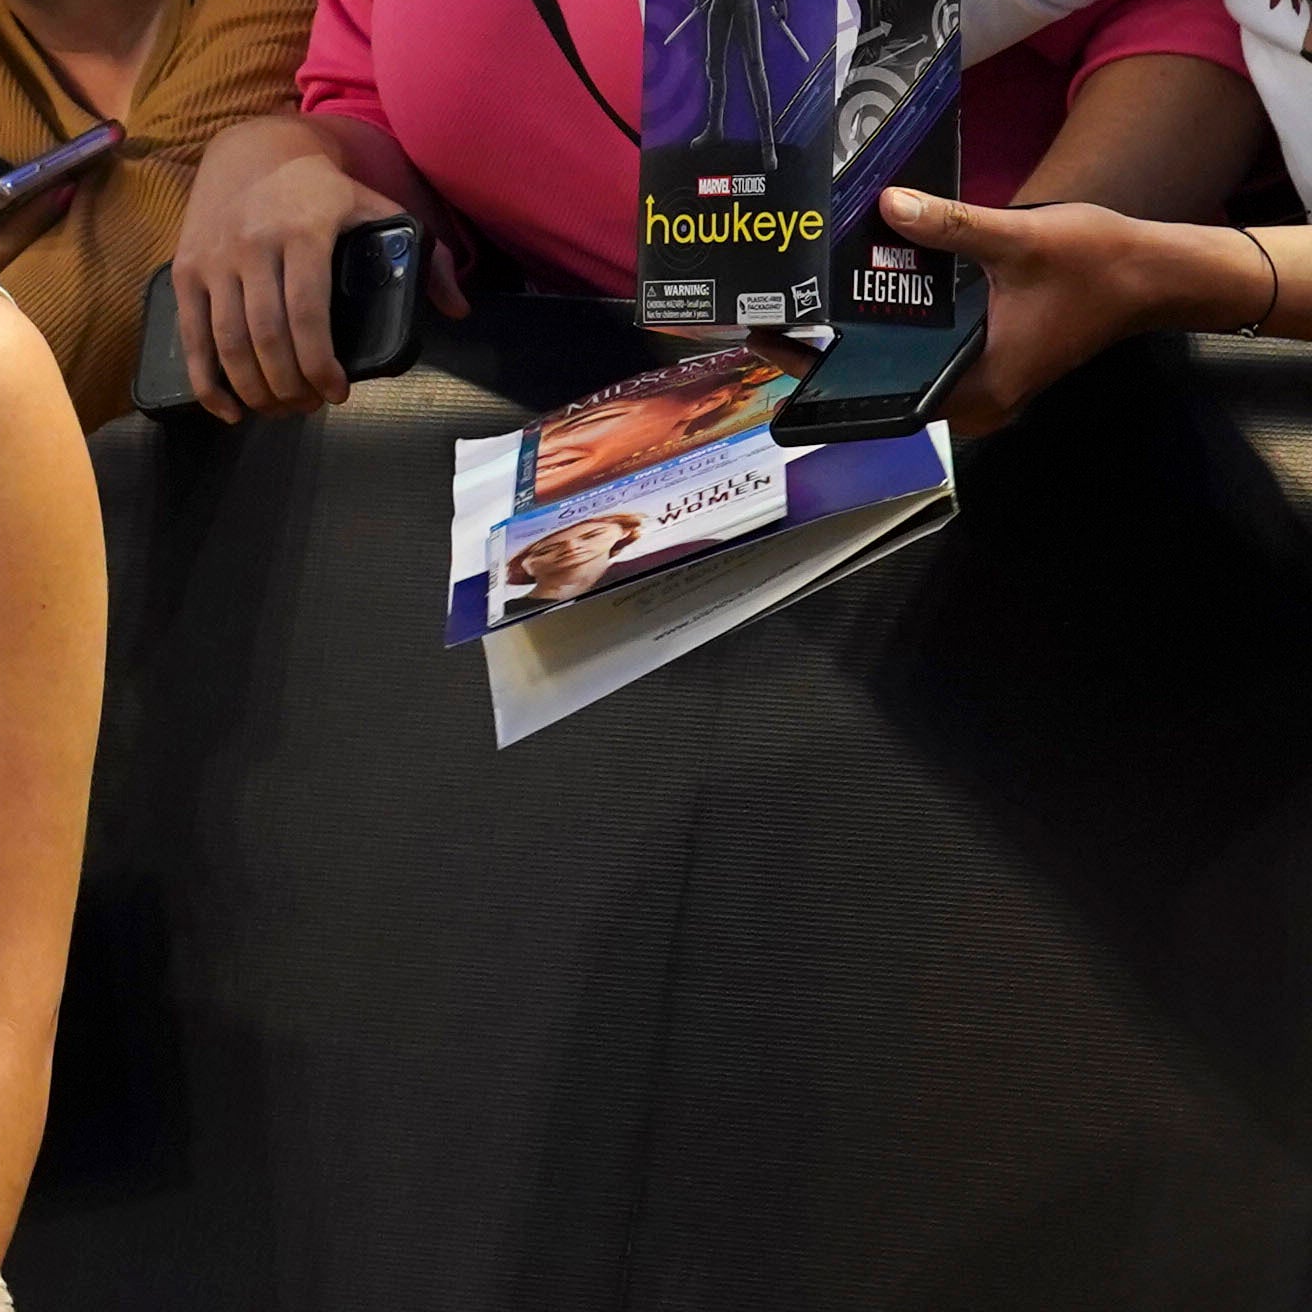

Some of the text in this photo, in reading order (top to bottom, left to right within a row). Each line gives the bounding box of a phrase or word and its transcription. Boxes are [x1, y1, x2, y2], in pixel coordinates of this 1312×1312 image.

[698, 175, 766, 195] MARVEL STUDIOS
[645, 194, 824, 253] hawkeye
[872, 246, 917, 269] MARVEL
[664, 284, 710, 296] WARNING:
[853, 269, 934, 306] LEGENDS
[567, 346, 750, 417] MIDSOMM
[640, 451, 730, 490] PICTURE
[657, 475, 772, 525] WOMEN
[665, 469, 760, 513] LITTLE
